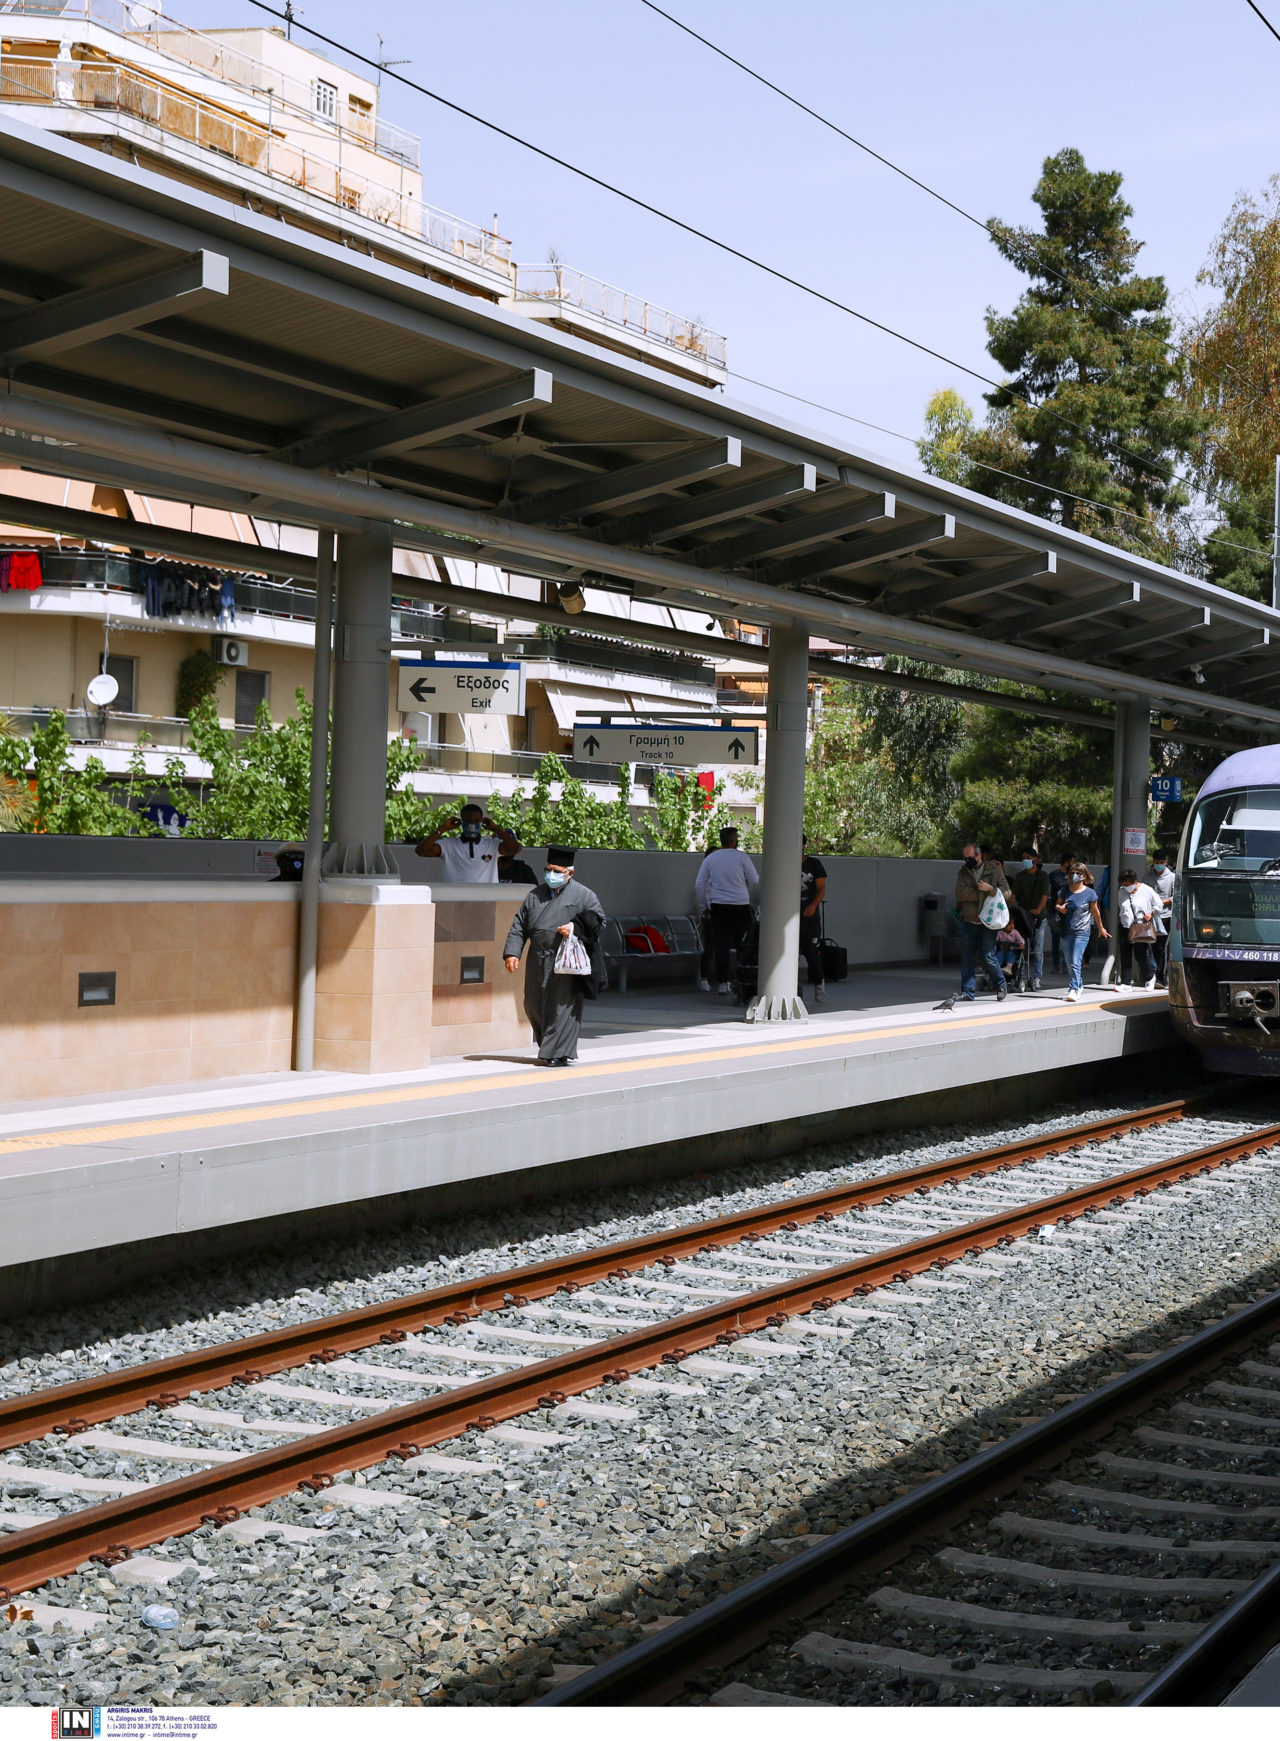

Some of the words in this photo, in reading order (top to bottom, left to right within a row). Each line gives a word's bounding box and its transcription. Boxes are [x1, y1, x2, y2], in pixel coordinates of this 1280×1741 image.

[453, 674, 510, 692] Έξοδος
[471, 697, 492, 709] Exit
[629, 734, 670, 748] Γραμμή
[672, 735, 685, 746] 10
[639, 751, 663, 759] Track
[664, 751, 674, 759] 10
[1156, 779, 1170, 791] 10
[1242, 951, 1260, 960] 460
[1262, 952, 1279, 961] 118
